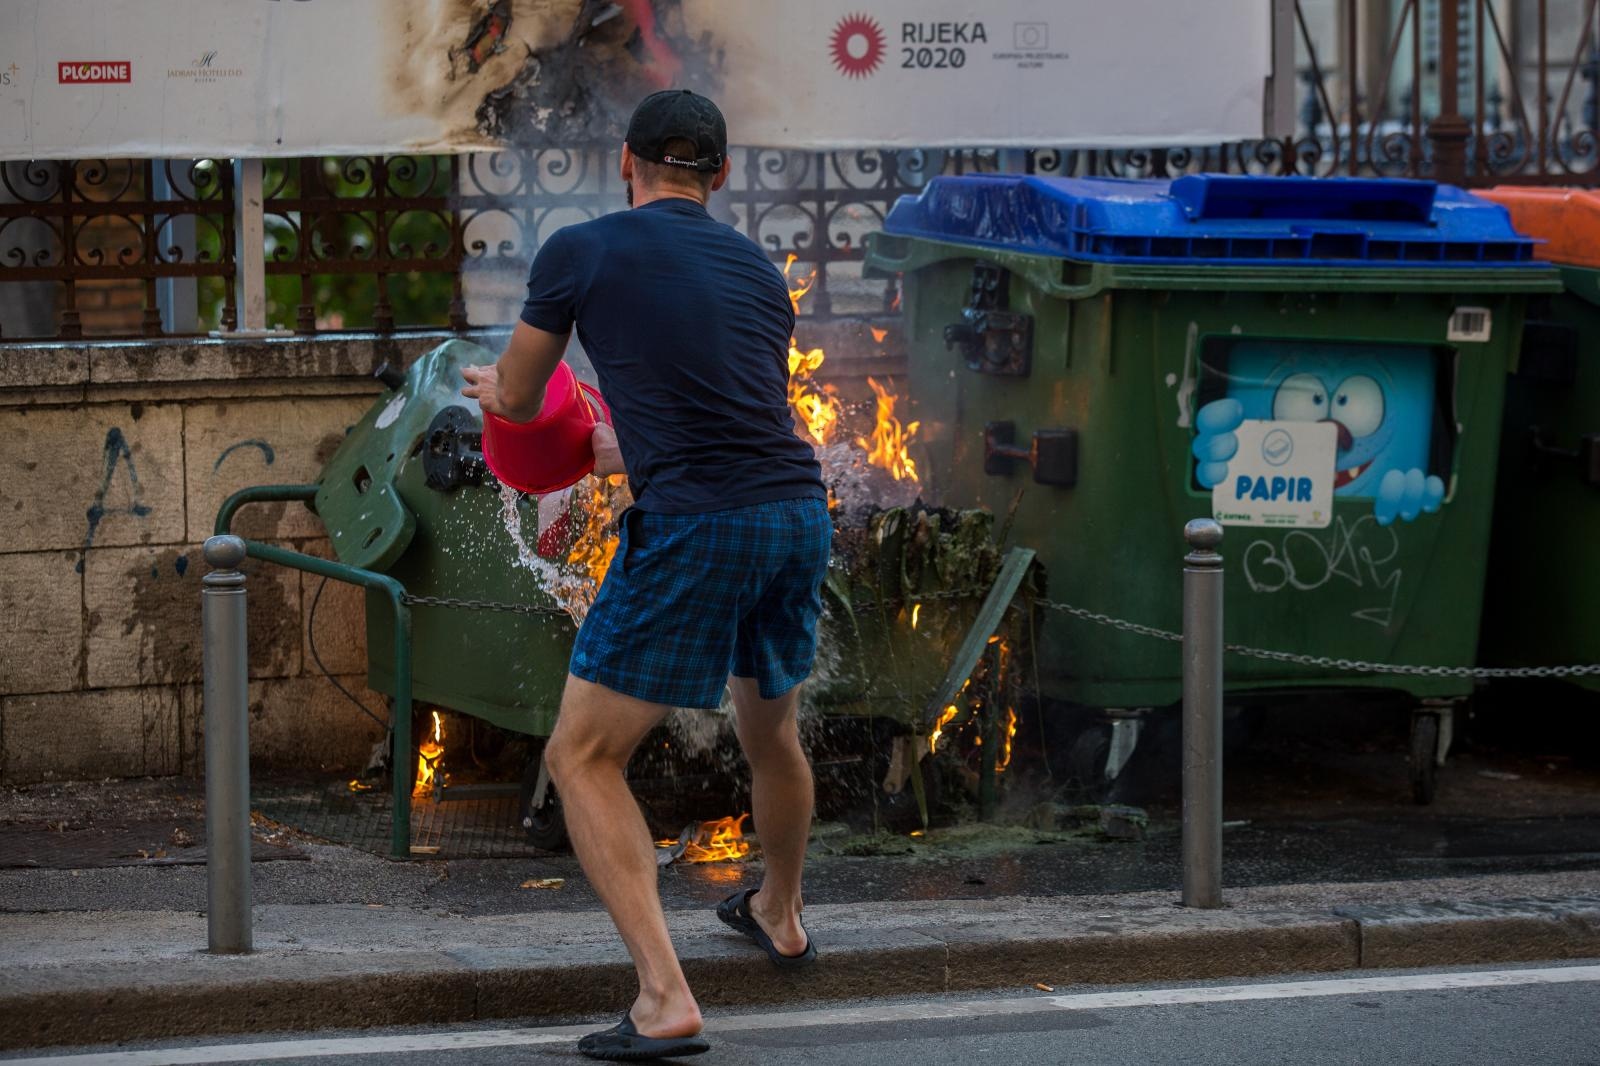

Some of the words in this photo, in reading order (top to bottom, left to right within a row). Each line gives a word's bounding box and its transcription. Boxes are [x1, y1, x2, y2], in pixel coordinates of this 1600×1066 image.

[902, 22, 987, 43] RIJEKA
[901, 47, 966, 69] 2020
[62, 65, 127, 80] PLODINE
[1236, 475, 1312, 502] PAPIR
